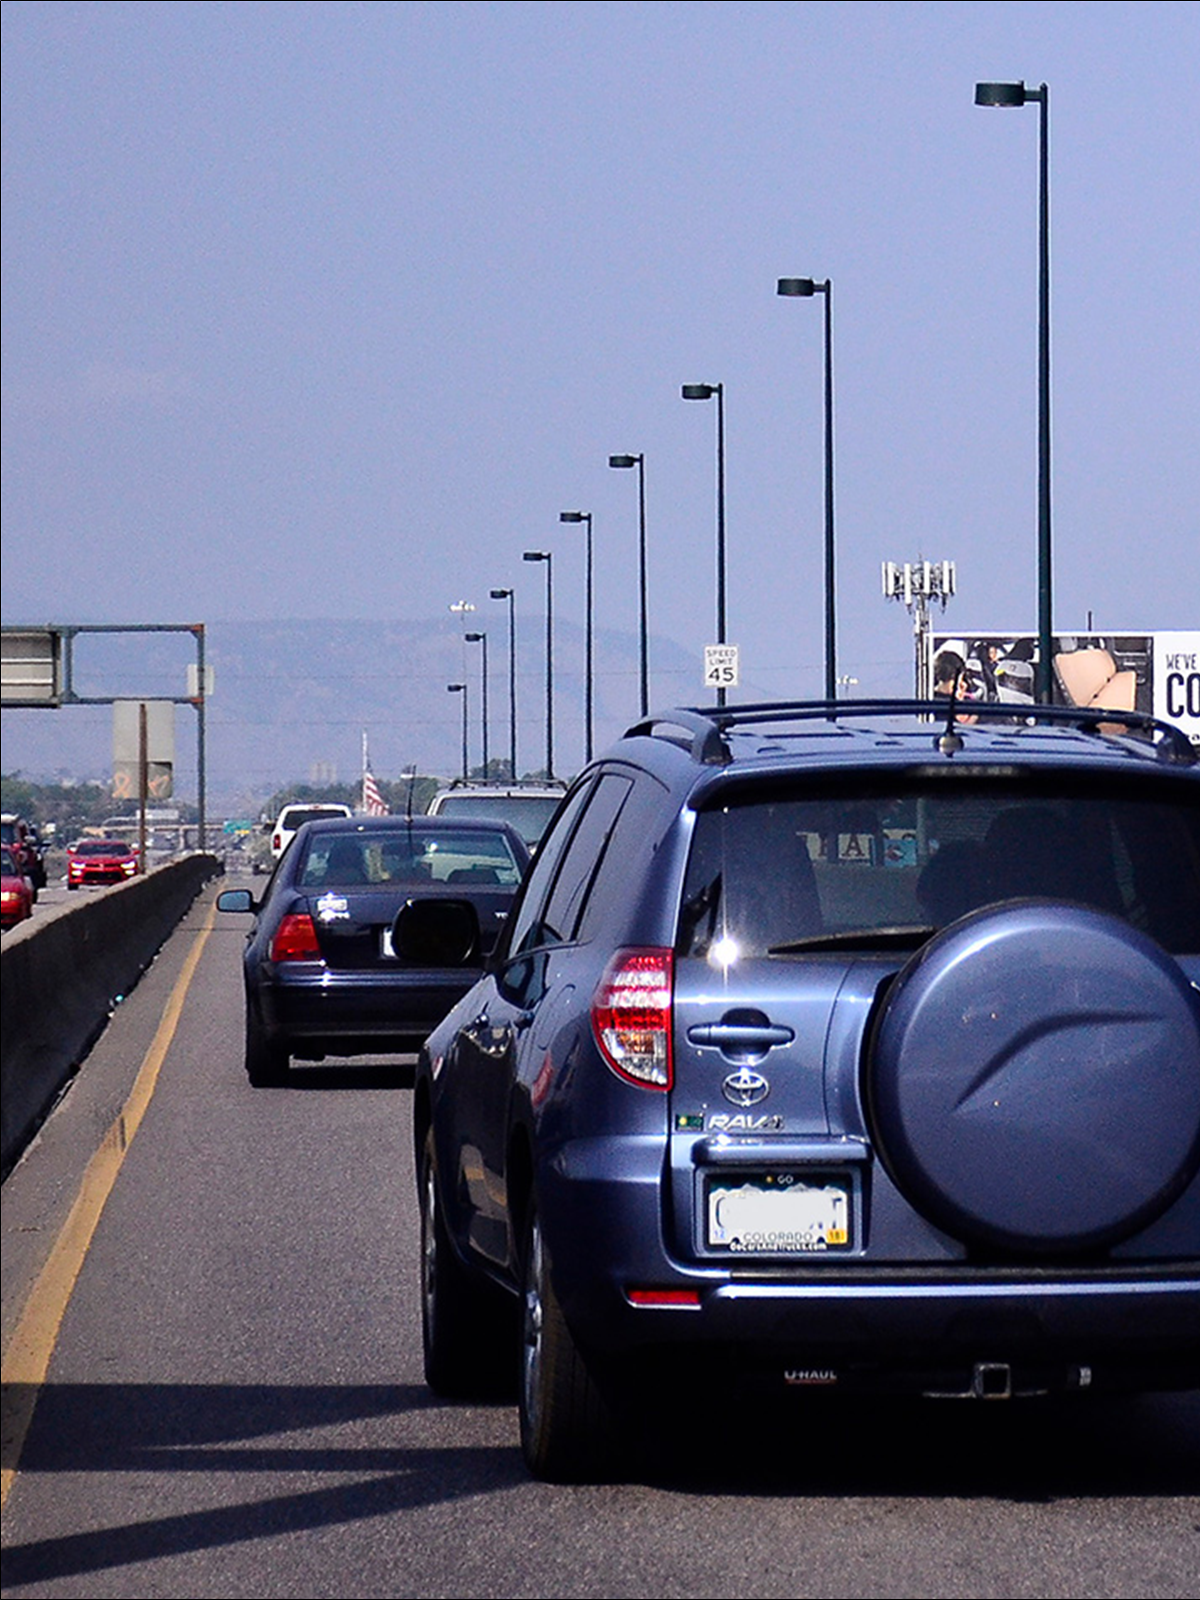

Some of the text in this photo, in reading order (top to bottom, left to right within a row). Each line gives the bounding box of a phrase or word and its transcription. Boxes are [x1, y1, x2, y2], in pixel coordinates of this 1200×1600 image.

[707, 649, 737, 657] SPEED
[709, 658, 732, 666] LIMIT
[1166, 654, 1197, 670] WE'VE
[709, 667, 735, 682] 45
[743, 1231, 813, 1243] COLORADO
